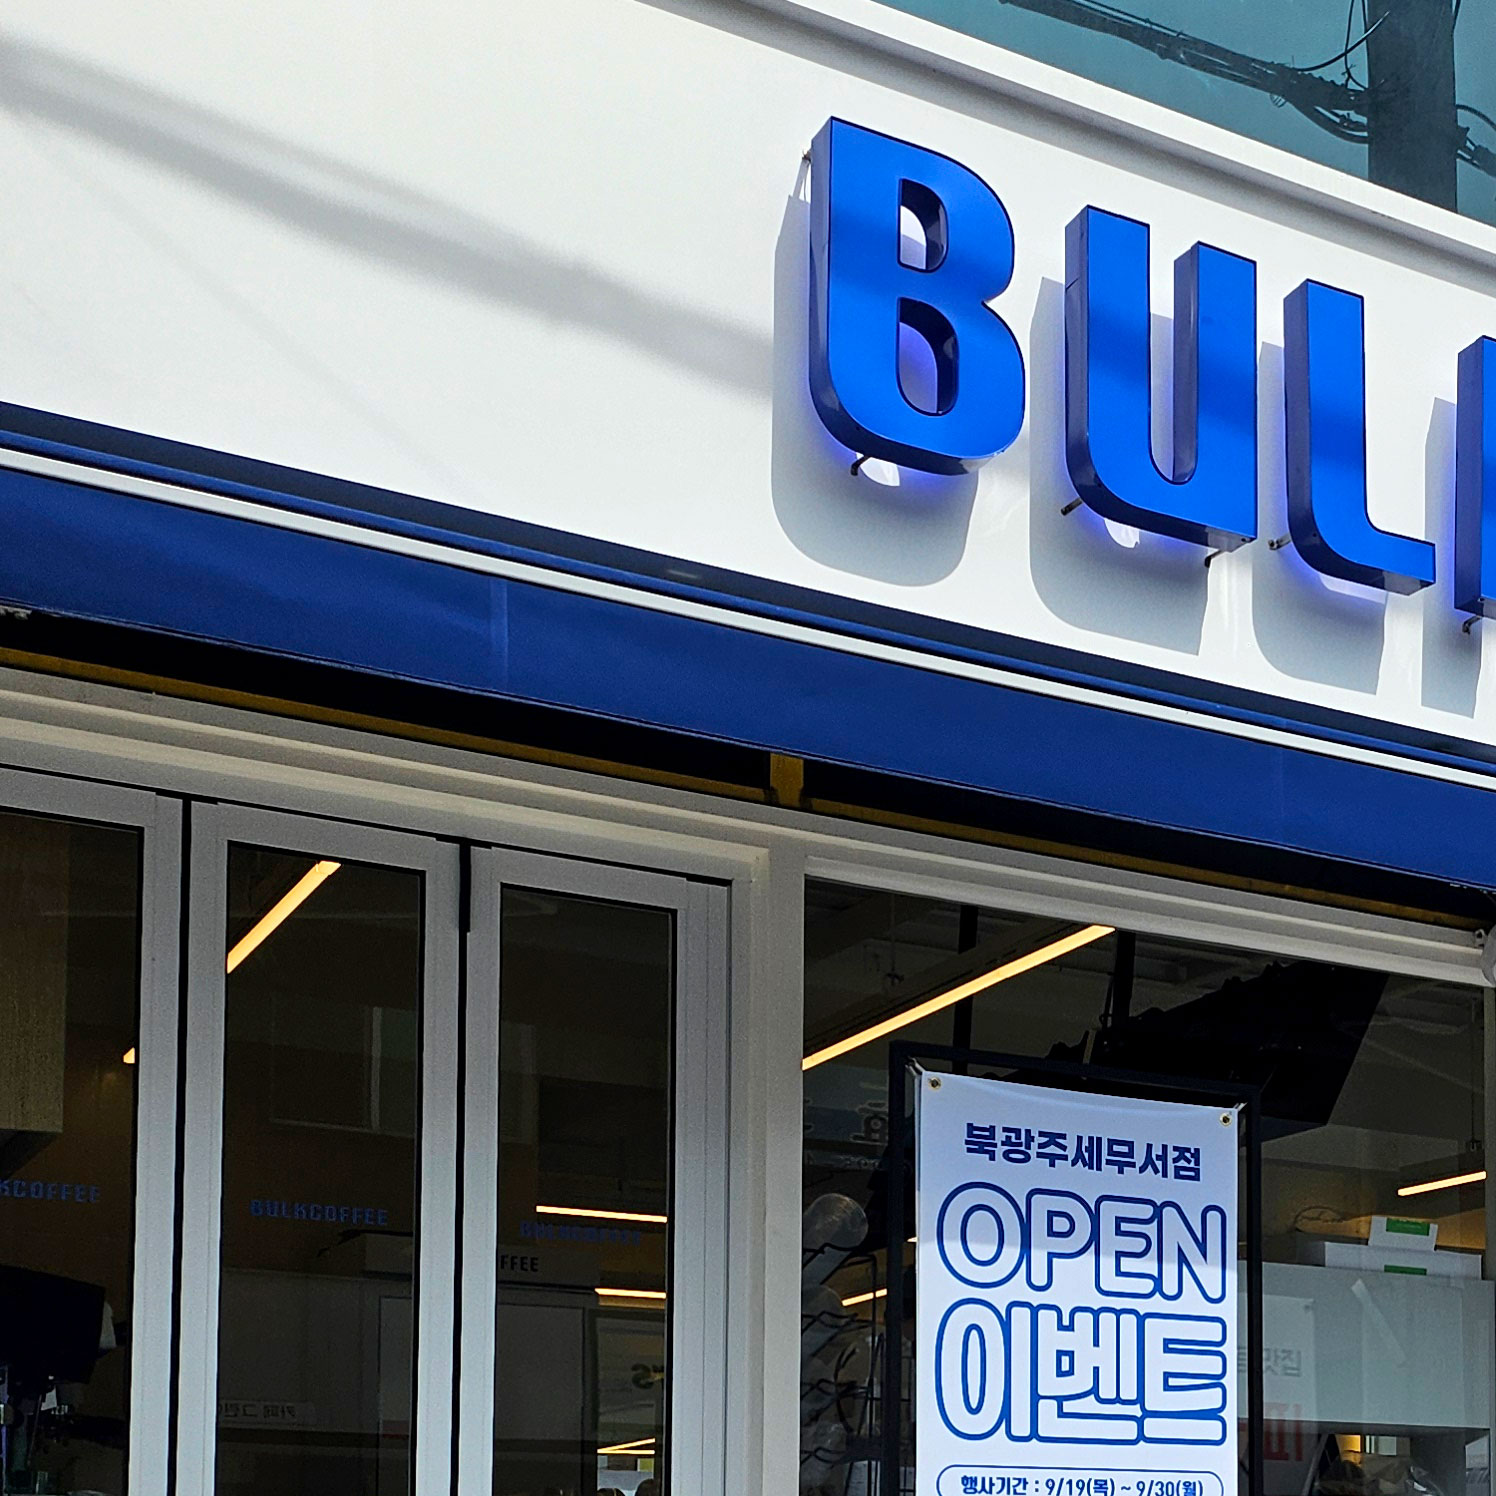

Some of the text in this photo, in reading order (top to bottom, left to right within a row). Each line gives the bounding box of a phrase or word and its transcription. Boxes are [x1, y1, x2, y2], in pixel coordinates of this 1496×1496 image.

[964, 1122, 1202, 1182] 북광주세무서점
[936, 1181, 1228, 1304] OPEN
[934, 1297, 1228, 1446] 이벤트
[960, 1474, 1029, 1496] 행사기간
